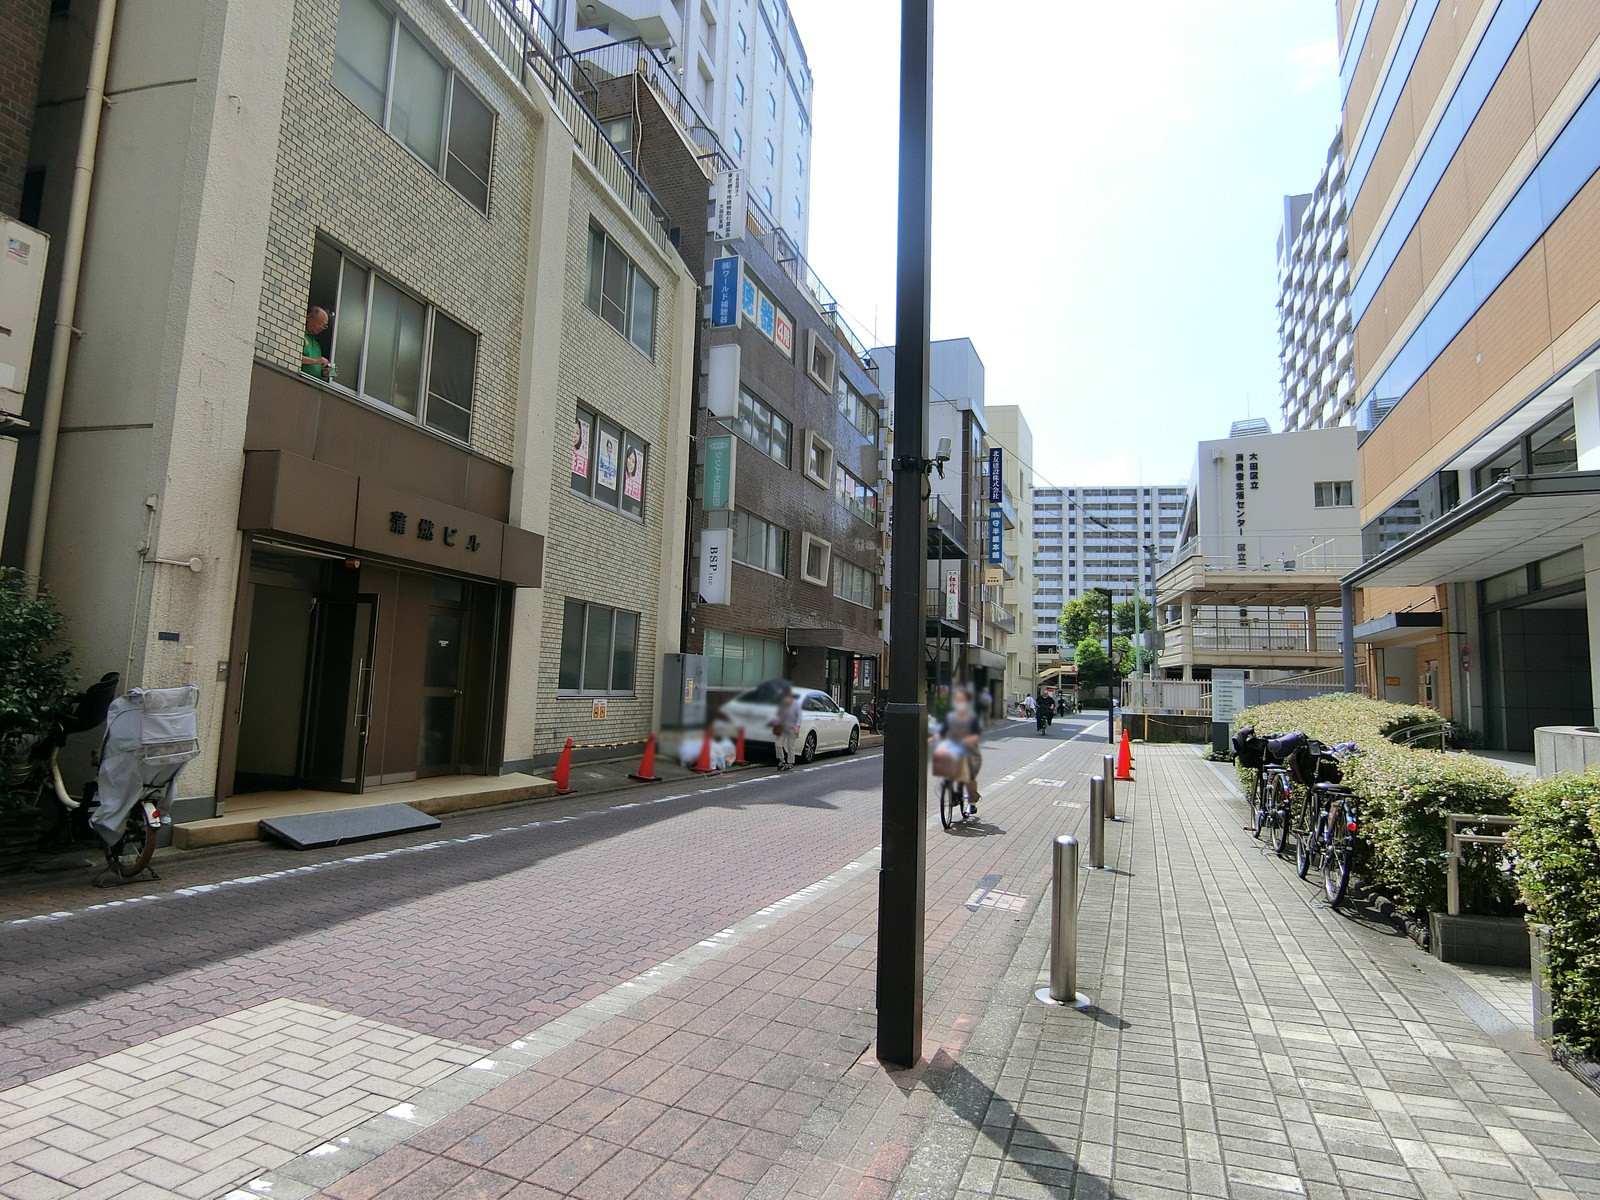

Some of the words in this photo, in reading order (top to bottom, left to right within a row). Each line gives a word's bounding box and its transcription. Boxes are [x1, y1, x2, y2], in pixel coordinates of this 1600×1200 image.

[1235, 453, 1246, 536] 消費者生活センター
[1249, 453, 1259, 490] 大田区立
